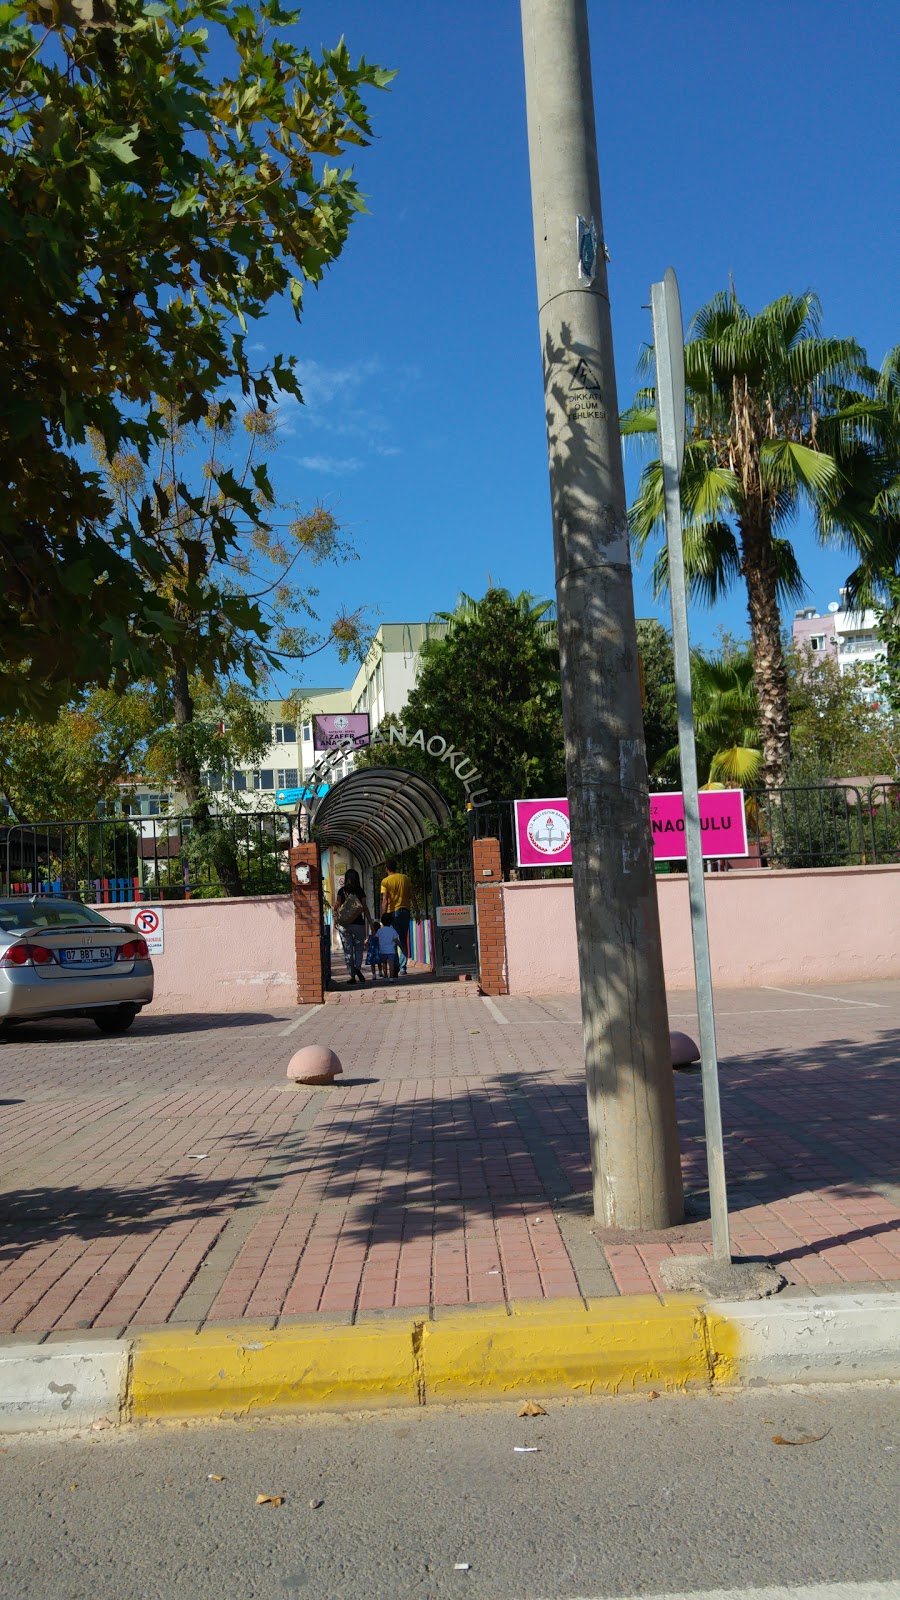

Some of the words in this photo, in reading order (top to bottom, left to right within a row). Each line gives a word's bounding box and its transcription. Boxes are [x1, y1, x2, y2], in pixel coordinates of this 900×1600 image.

[575, 401, 598, 410] ÖLÜM
[370, 725, 492, 808] ANAOKULU
[66, 950, 75, 960] 07
[80, 949, 93, 959] BBT
[100, 949, 109, 958] 64
